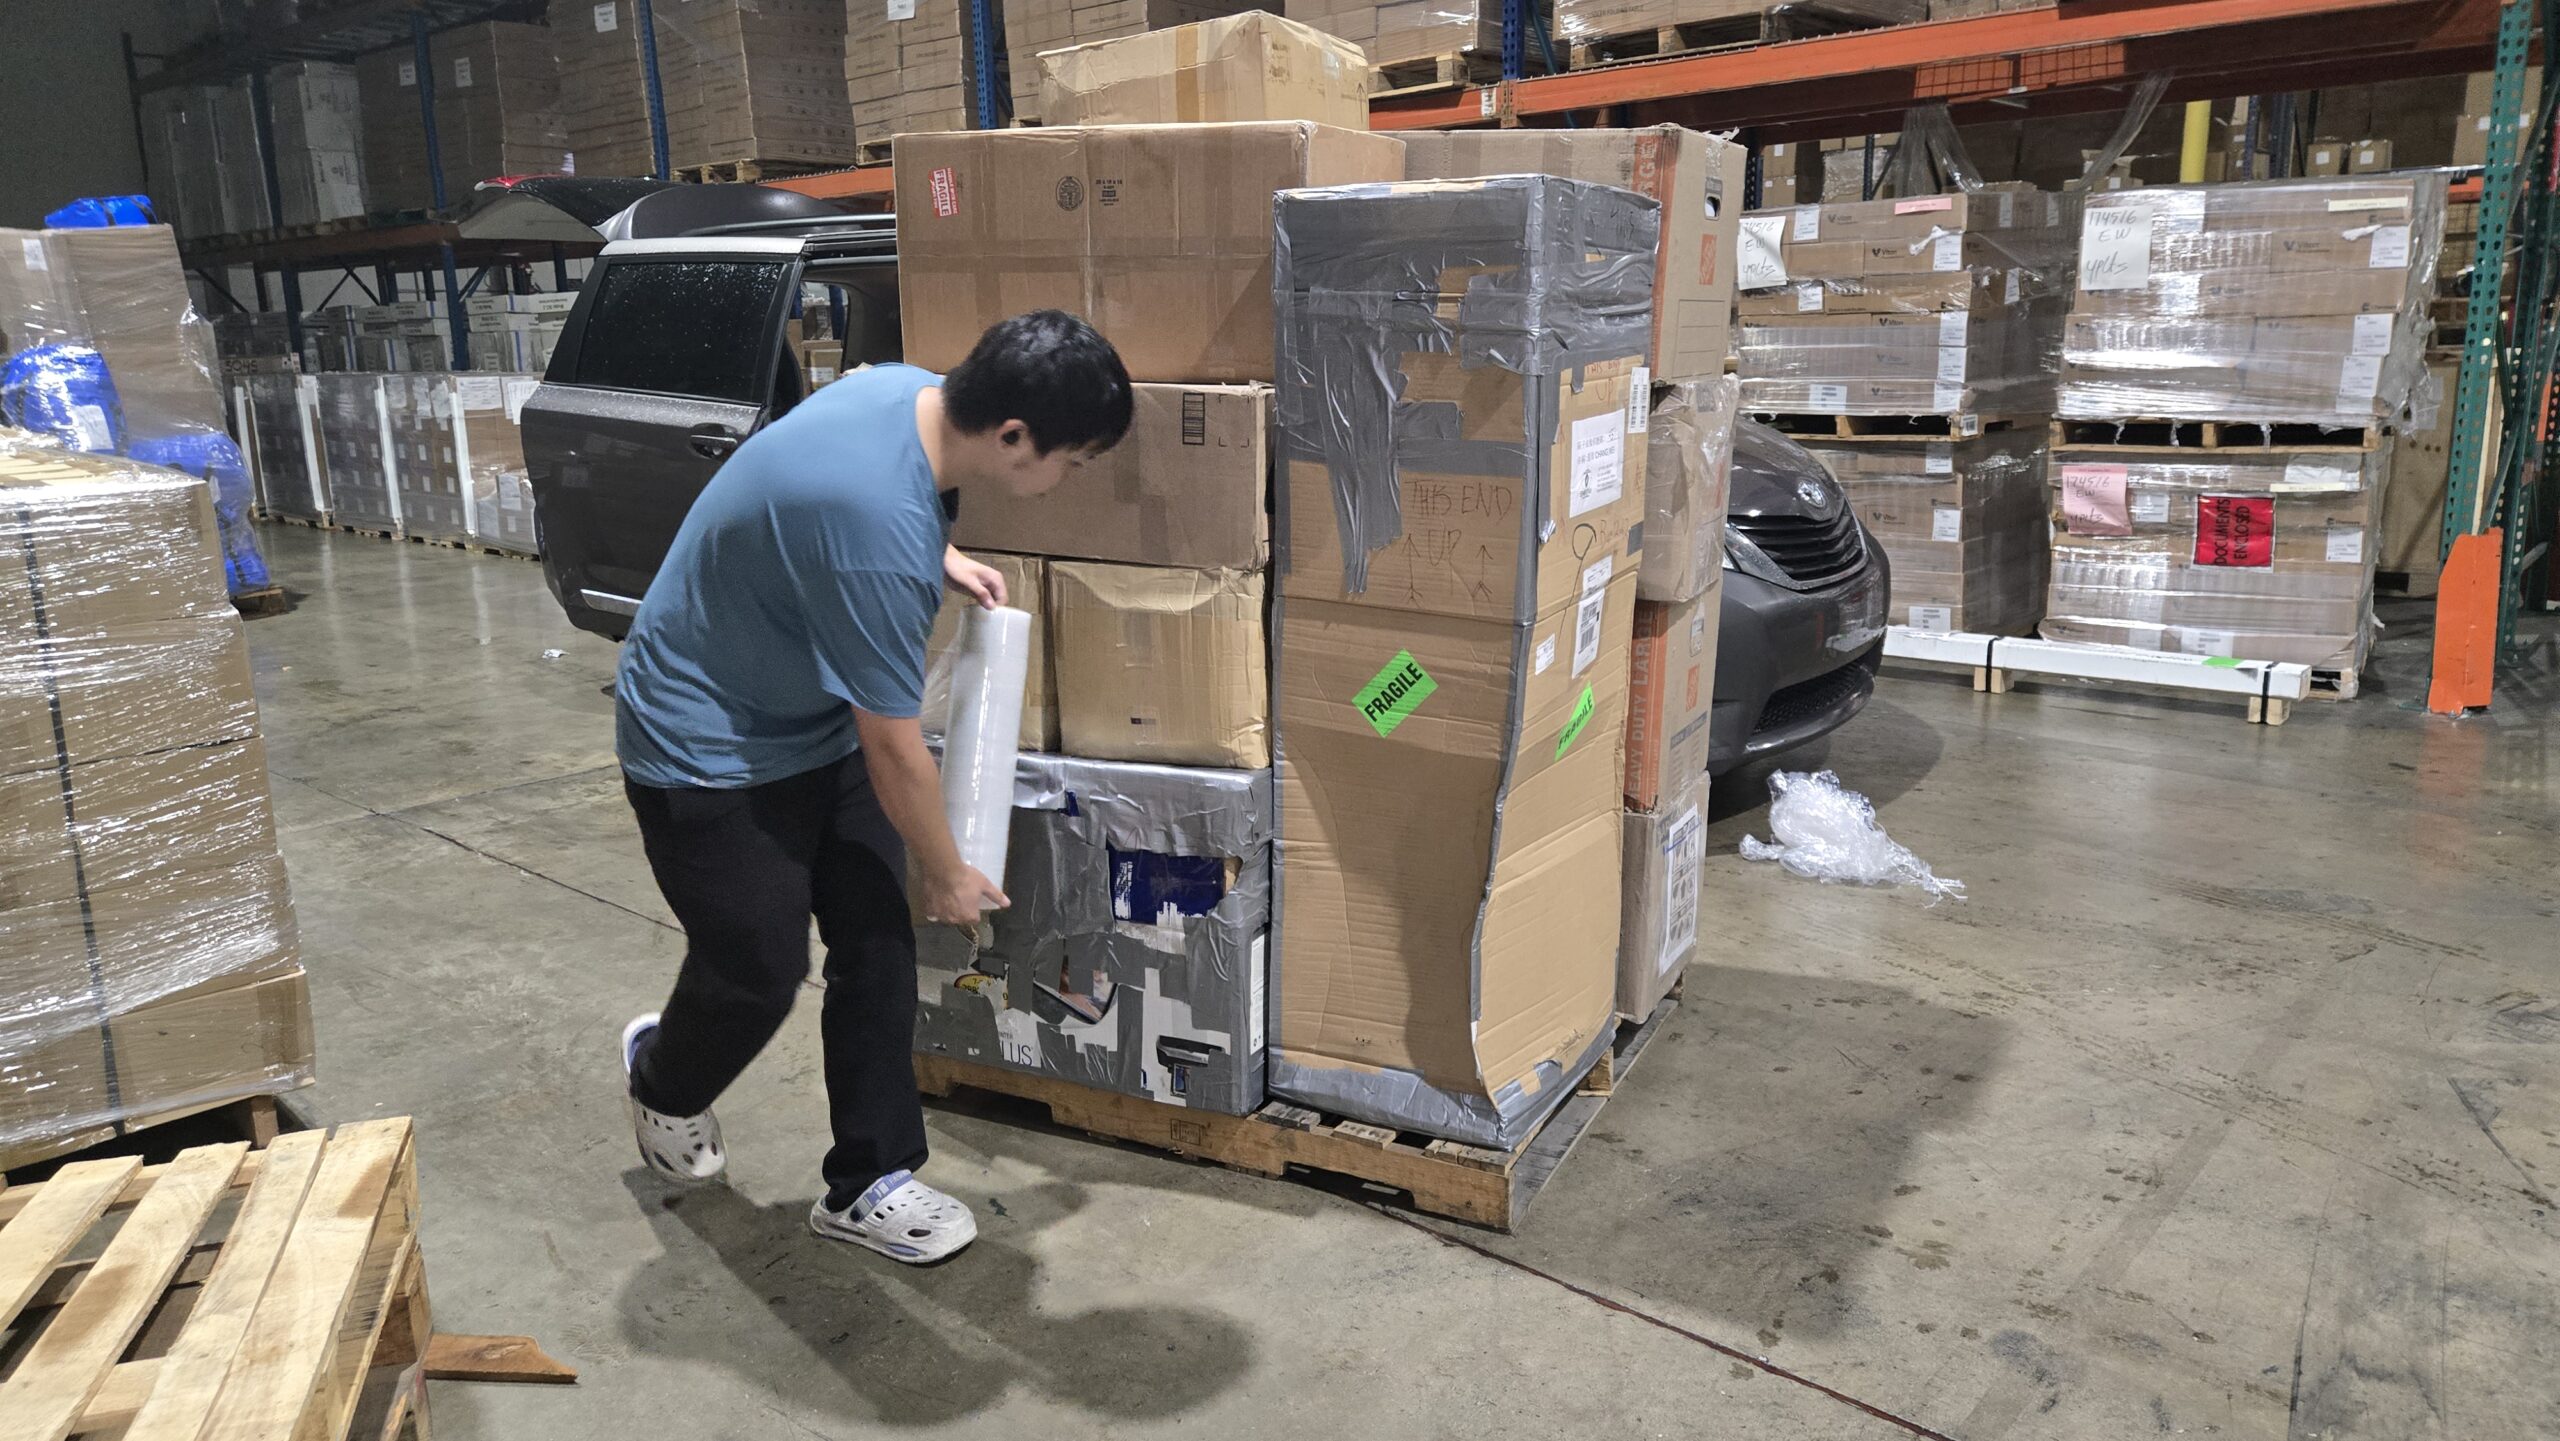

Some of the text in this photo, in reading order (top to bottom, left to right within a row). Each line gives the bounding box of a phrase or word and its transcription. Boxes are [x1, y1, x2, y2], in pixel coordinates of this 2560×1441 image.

[936, 170, 950, 216] FRAGILE
[2089, 210, 2137, 227] 174516
[1405, 479, 1513, 520] THIS END
[2214, 498, 2231, 566] DOCUMENTS
[2233, 505, 2250, 561] ENCLOSED
[1634, 609, 1654, 687] LARGE
[1364, 662, 1424, 723] FRAGILE
[1631, 694, 1647, 741] DUTY
[1558, 694, 1593, 750] FRAGILE
